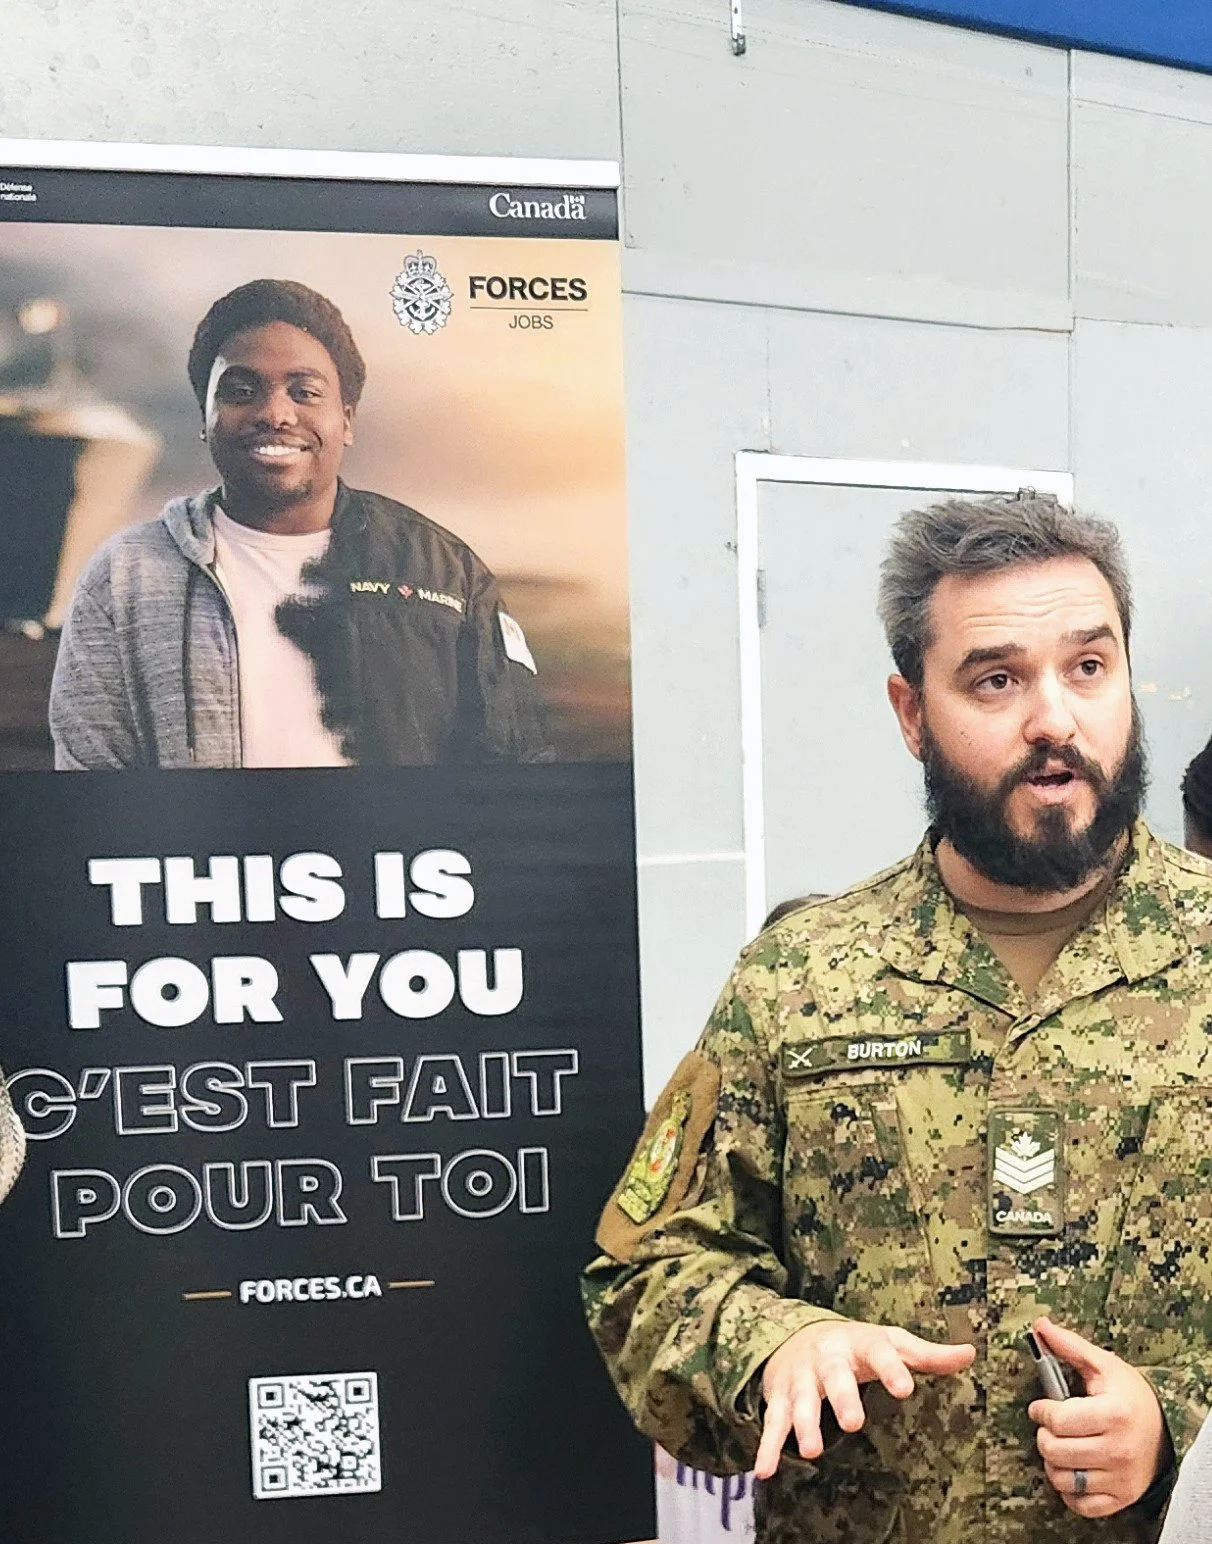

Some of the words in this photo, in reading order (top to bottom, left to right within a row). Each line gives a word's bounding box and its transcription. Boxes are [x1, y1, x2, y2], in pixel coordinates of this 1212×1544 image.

[489, 192, 588, 220] Canada
[468, 275, 588, 302] FORCES
[508, 314, 554, 330] JOBS
[349, 581, 390, 594] NAVY
[89, 852, 346, 926] THIS
[374, 849, 475, 919] IS
[67, 955, 284, 1029] FOR
[310, 948, 524, 1020] YOU
[847, 1040, 922, 1060] BURTON
[3, 1059, 317, 1141] C'EST
[343, 1049, 579, 1126] FAIT
[50, 1158, 348, 1239] POUR
[372, 1147, 550, 1221] TOI
[995, 1209, 1054, 1224] CANADA
[239, 1275, 383, 1304] FORCES.CA
